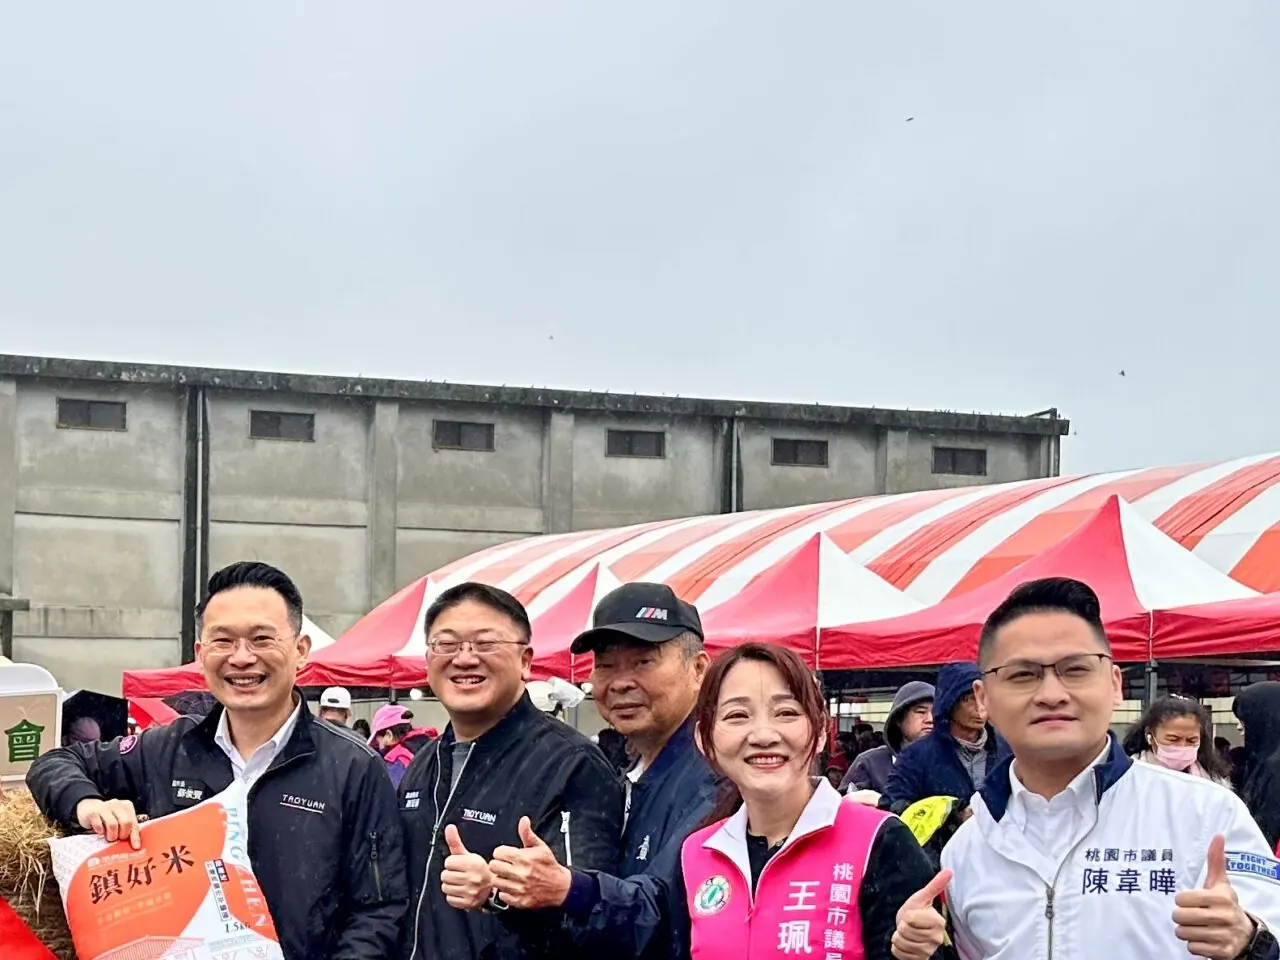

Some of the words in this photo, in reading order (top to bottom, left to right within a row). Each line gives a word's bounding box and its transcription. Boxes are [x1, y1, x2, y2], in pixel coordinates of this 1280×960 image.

[282, 794, 326, 811] TAOYUAN
[1085, 848, 1174, 863] 桃園市議員
[1240, 853, 1266, 866] FIGHT
[89, 845, 195, 905] 鎮好米
